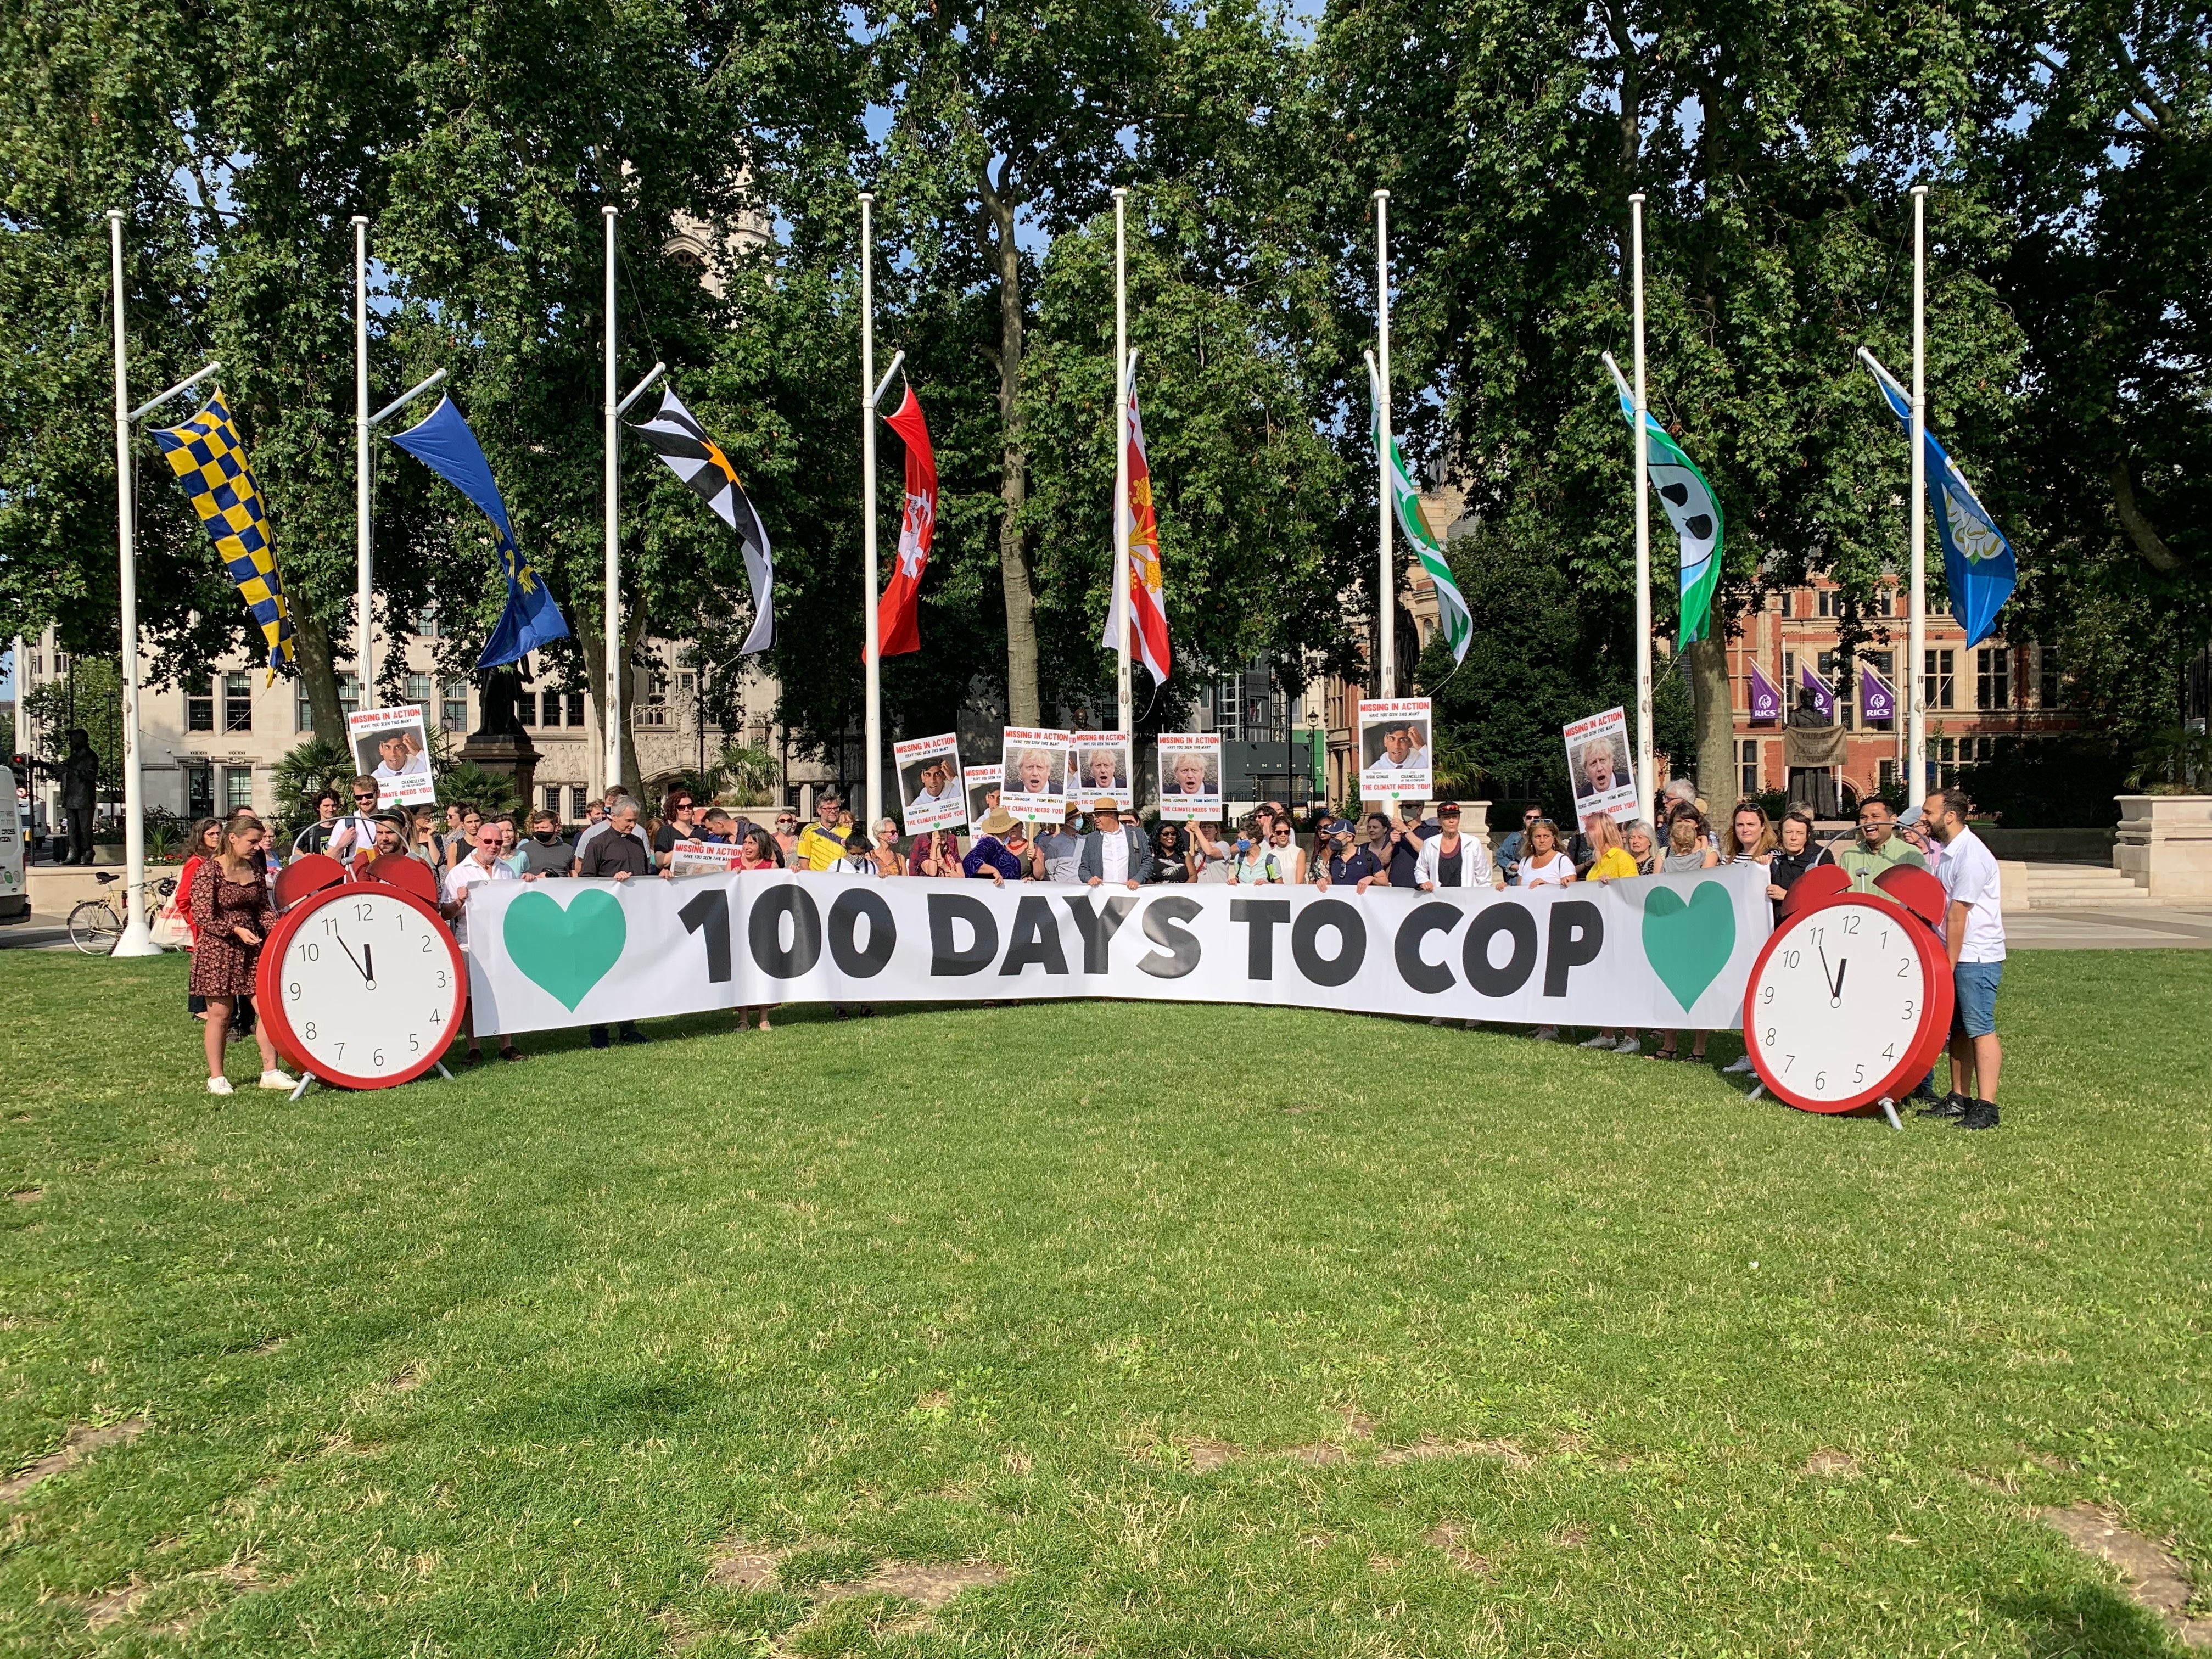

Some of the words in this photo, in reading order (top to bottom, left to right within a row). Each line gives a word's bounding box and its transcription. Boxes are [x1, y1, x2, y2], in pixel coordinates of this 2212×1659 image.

[351, 714, 380, 724] MISSING
[393, 709, 421, 719] ACTION
[1565, 723, 1588, 737] MISSING
[1590, 720, 1596, 728] IN
[1599, 711, 1622, 726] ACTION
[896, 743, 922, 754] MISSING
[933, 737, 955, 747] ACTION
[1797, 745, 1835, 754] COURAGE
[1608, 804, 1622, 814] NEEDS
[1625, 800, 1636, 809] YOU!
[917, 816, 937, 824] CLIMATE
[675, 844, 704, 853] MISSING
[716, 848, 743, 856] ACTION
[354, 904, 373, 921] 12
[322, 918, 338, 935] 11
[396, 914, 403, 931] 1
[1842, 916, 1861, 934] 12
[421, 935, 432, 952] 2
[677, 884, 896, 983] 100
[927, 893, 1205, 979] DAYS
[1230, 899, 1367, 987] TO
[1394, 900, 1604, 997] COP
[1810, 927, 1824, 945] 11
[1880, 931, 1888, 949] 1
[299, 943, 319, 961] 10
[1783, 950, 1800, 968] 10
[1897, 958, 1910, 977] 2
[436, 971, 446, 988] 3
[290, 983, 301, 1001] 9
[1764, 987, 1774, 1004] 9
[429, 1008, 440, 1025] 4
[1902, 1000, 1913, 1020] 3
[306, 1022, 317, 1040] 8
[1766, 1028, 1776, 1046] 8
[410, 1034, 419, 1051] 5
[334, 1043, 345, 1060] 7
[373, 1049, 384, 1066] 6
[1882, 1043, 1894, 1062] 4
[1784, 1055, 1795, 1073] 7
[1815, 1071, 1826, 1090] 6
[1853, 1064, 1864, 1083] 5
